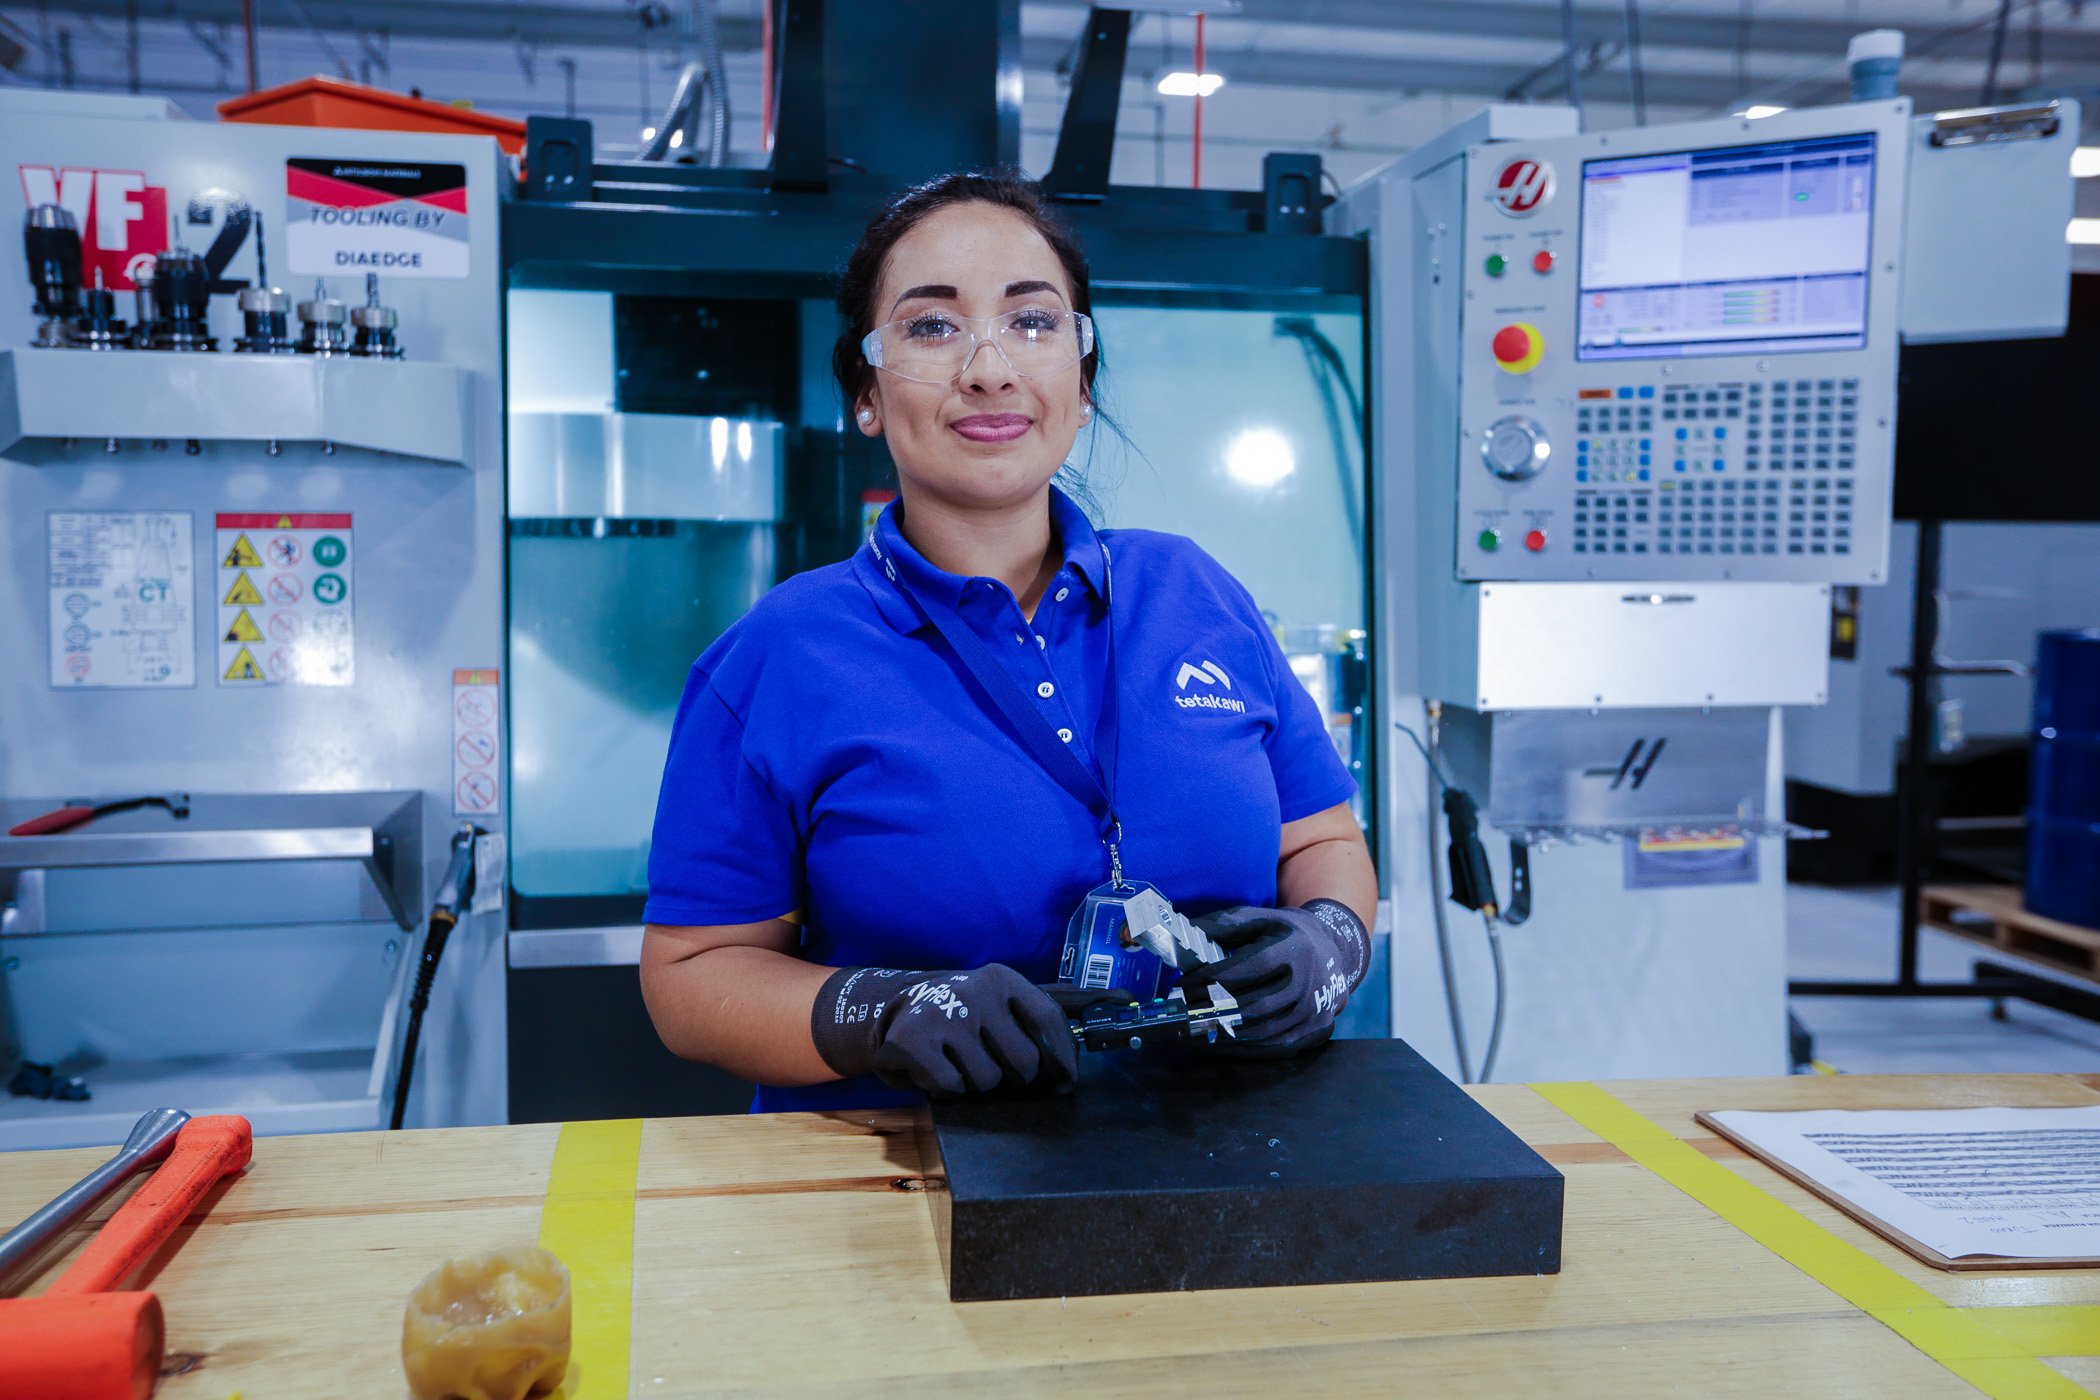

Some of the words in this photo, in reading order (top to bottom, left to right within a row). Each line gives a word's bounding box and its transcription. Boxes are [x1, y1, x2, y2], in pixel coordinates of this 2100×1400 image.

[310, 207, 408, 227] TOOLING
[415, 210, 446, 228] BY
[335, 250, 422, 268] DIAEDGE
[1314, 973, 1347, 1014] HyFlex
[873, 1001, 885, 1018] 10
